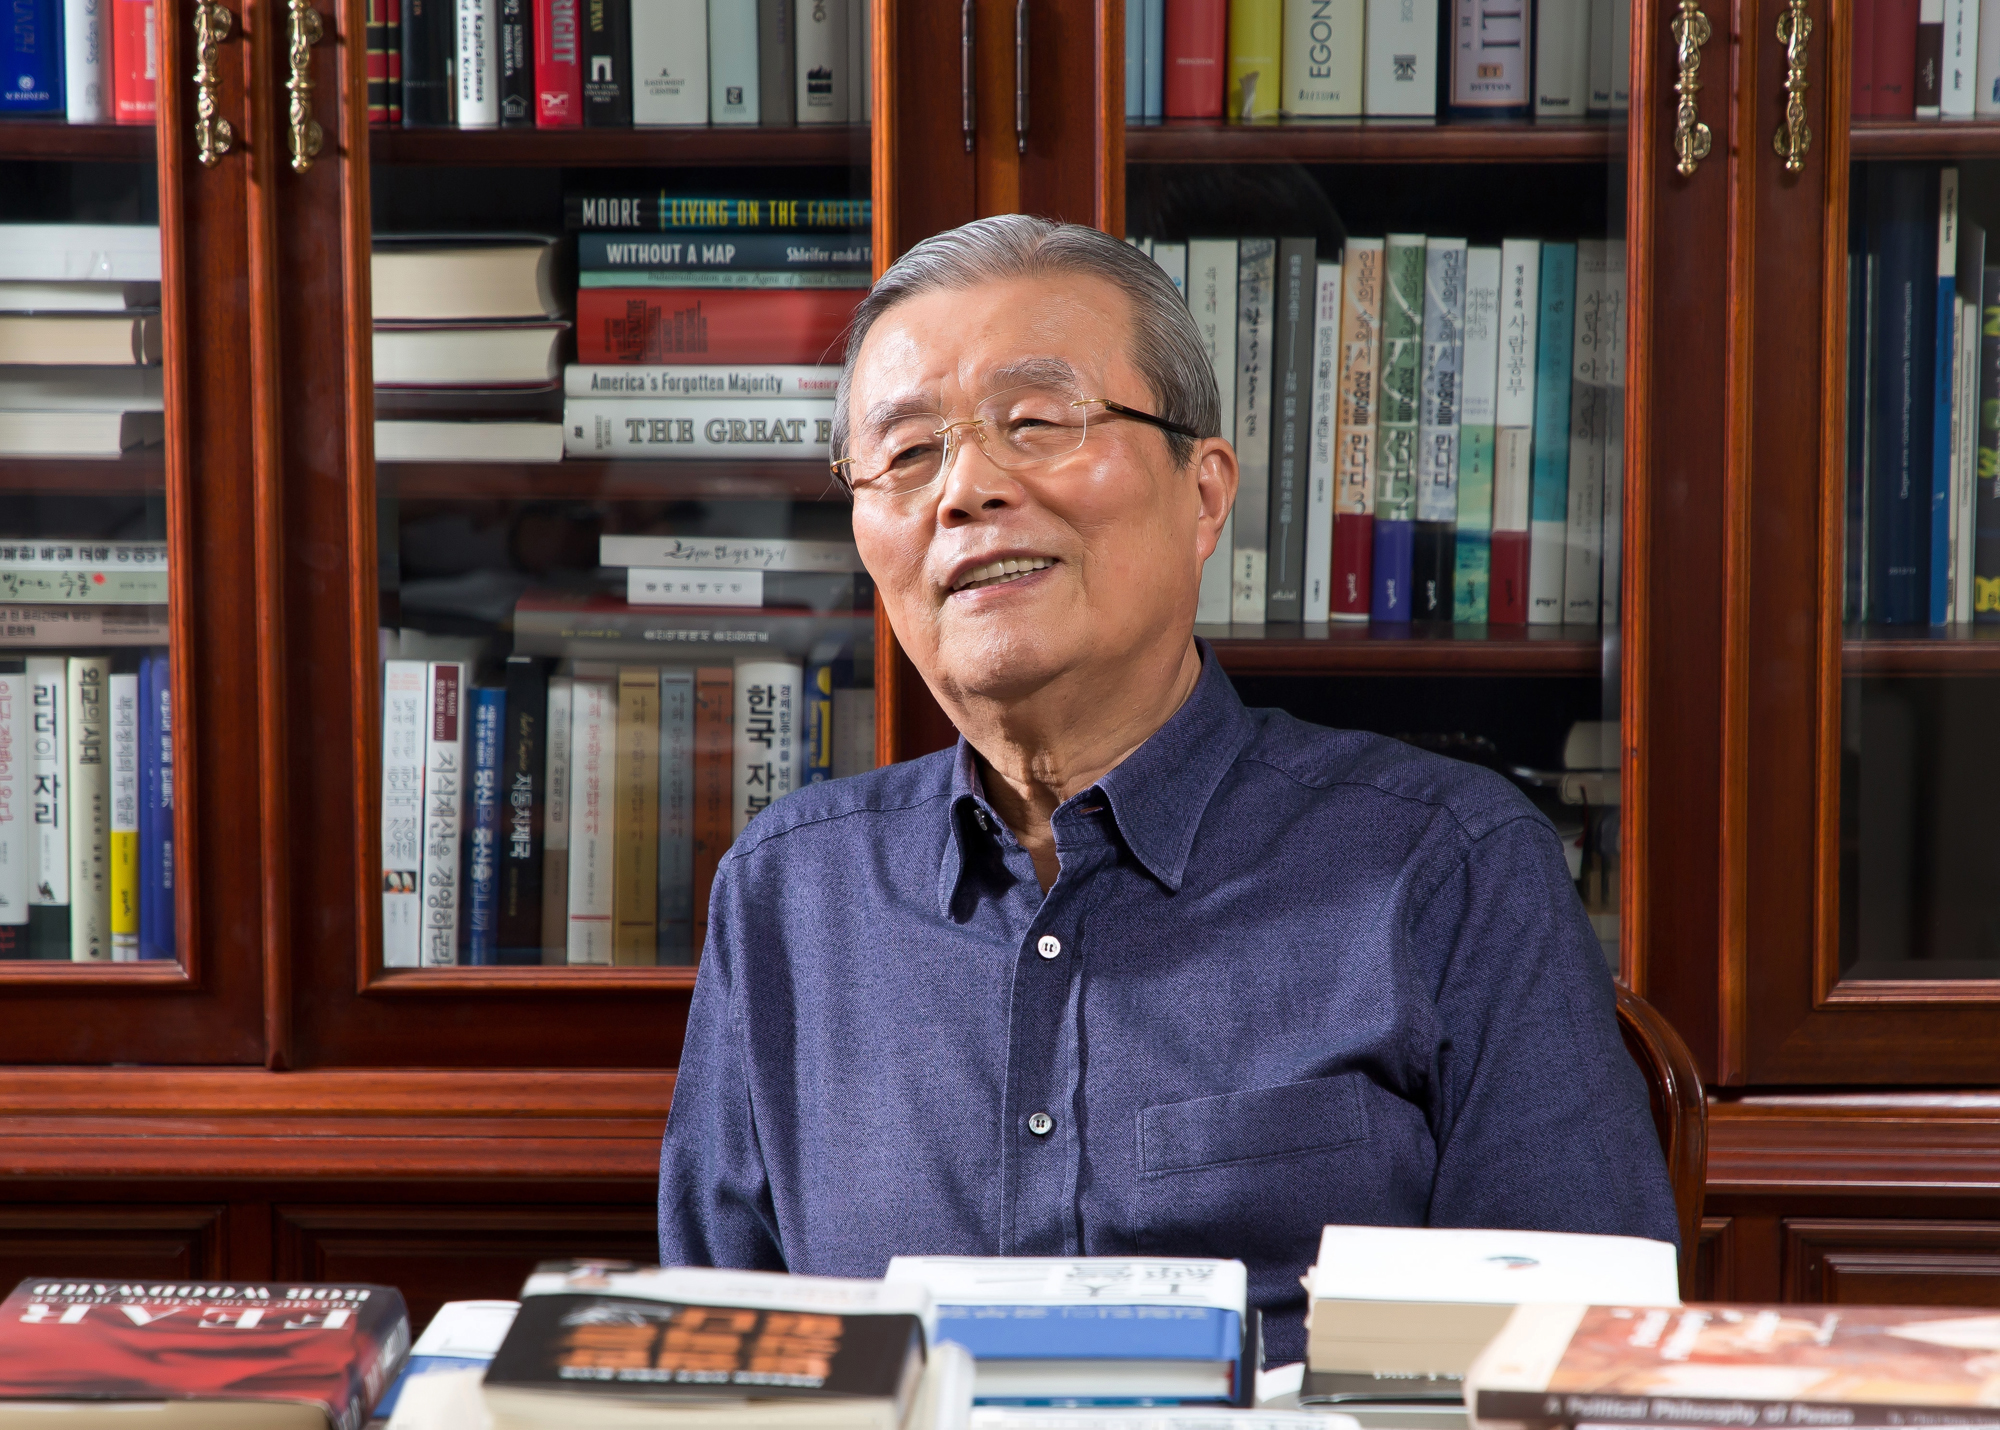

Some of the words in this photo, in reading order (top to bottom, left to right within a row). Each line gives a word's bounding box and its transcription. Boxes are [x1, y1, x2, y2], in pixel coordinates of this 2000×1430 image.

[461, 17, 469, 52] seine
[474, 14, 486, 103] Kapitalismus
[1309, 0, 1332, 79] EGON
[461, 57, 471, 100] Krisen
[582, 198, 641, 226] MOORE
[672, 200, 729, 226] LIVING
[737, 200, 760, 226] ON
[768, 200, 798, 226] THE
[606, 243, 682, 264] WITHOUT
[686, 244, 698, 263] A
[702, 244, 736, 264] MAP
[786, 246, 830, 263] Shleifer
[1358, 249, 1375, 307] 인문의
[1401, 246, 1419, 301] 인문의
[1442, 250, 1459, 307] 인문의
[591, 372, 658, 392] America's
[662, 372, 724, 394] Forgotten
[728, 372, 783, 394] Majority
[1352, 371, 1371, 426] 경영을
[1397, 367, 1415, 422] 경영을
[1437, 370, 1455, 426] 경영을
[625, 418, 694, 444] THE
[704, 418, 806, 444] GREAT
[1395, 431, 1413, 485] 만나다
[1350, 433, 1369, 489] 만나다
[1434, 434, 1453, 489] 만나다
[1352, 490, 1366, 515] 3
[79, 667, 101, 724] 외교의
[745, 684, 777, 750] 한국
[33, 684, 58, 765] 리더의
[79, 727, 102, 765] 시대
[435, 714, 446, 739] 이야기
[33, 773, 61, 829] 자리
[429, 751, 458, 860] 지식재산을
[473, 768, 495, 823] 당신은
[510, 772, 533, 859] 자동차제국
[470, 826, 494, 931] 중산층입니까
[427, 865, 455, 966] 경영하라
[20, 1305, 351, 1330] FEAR
[33, 1284, 271, 1300] WOODWARD
[286, 1287, 371, 1301] BOB
[1545, 1398, 1563, 1416] A
[1569, 1397, 1648, 1420] Political
[1656, 1400, 1758, 1426] Philosophy
[1763, 1404, 1788, 1424] of
[1792, 1405, 1854, 1425] Peace
